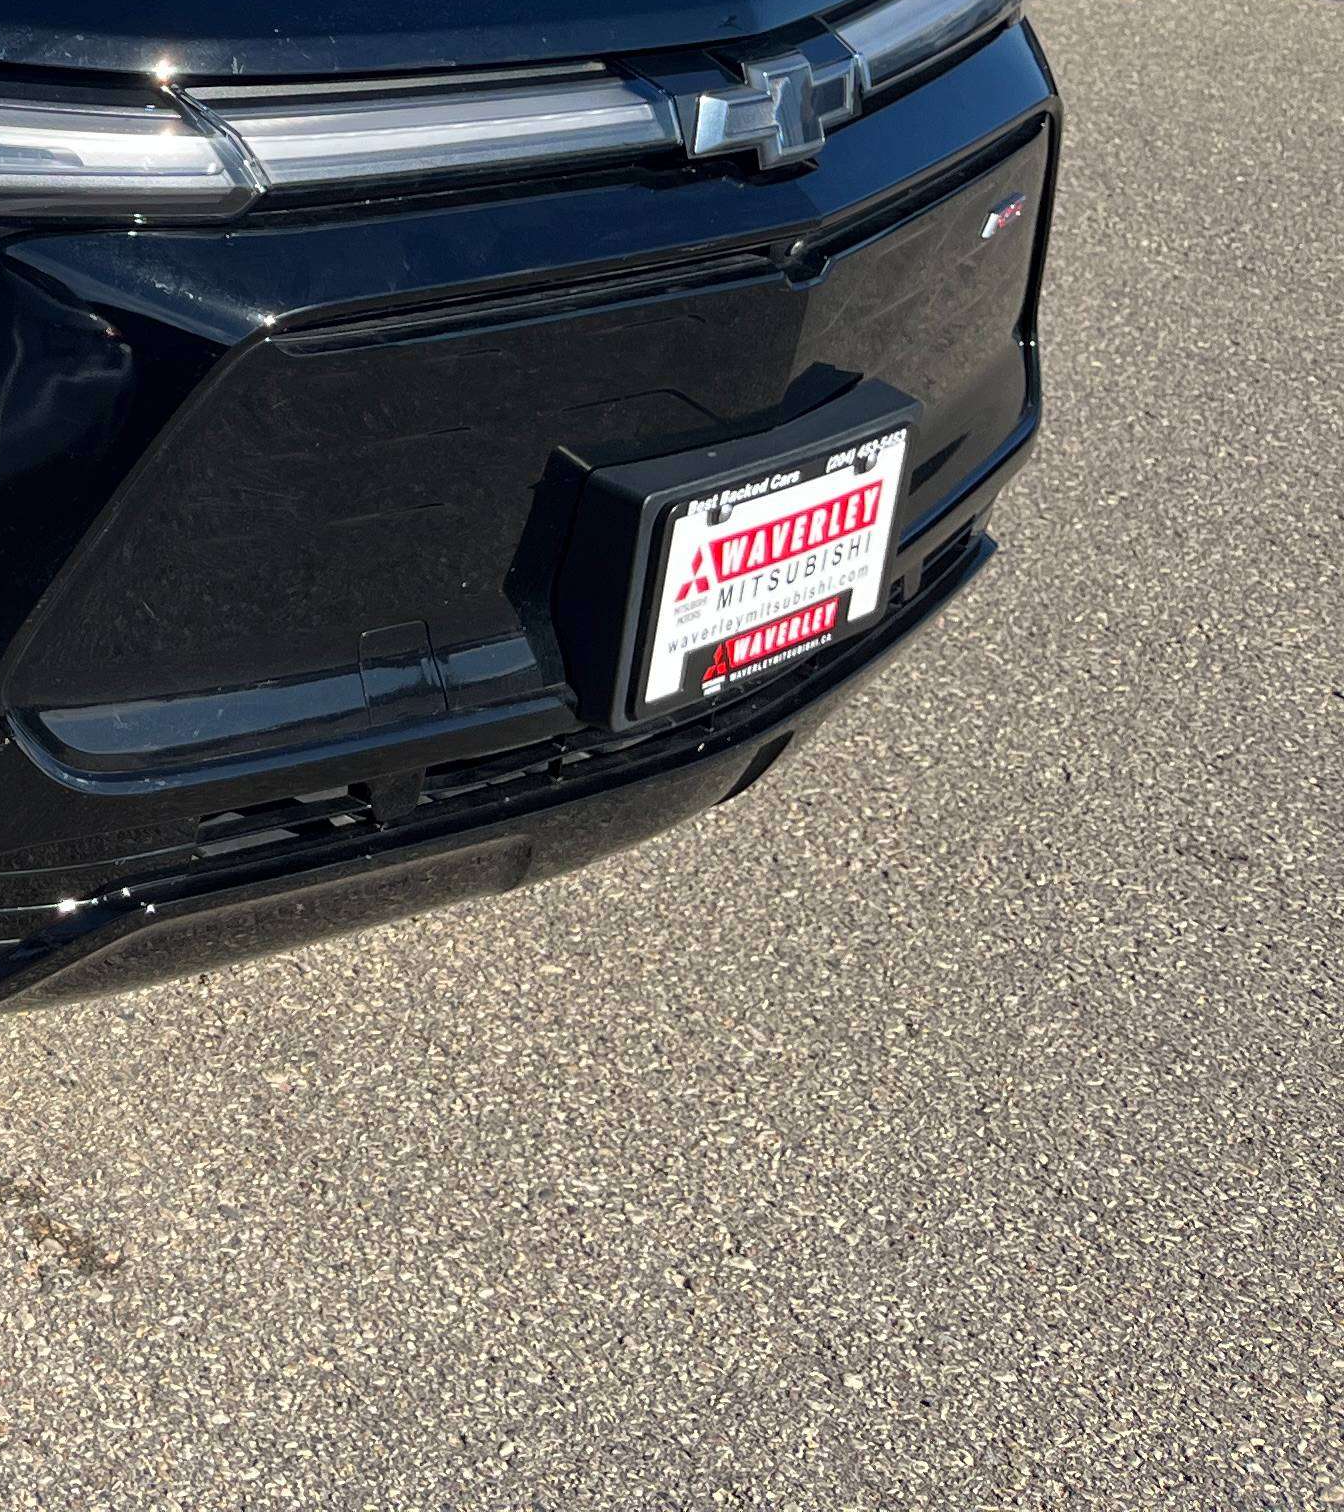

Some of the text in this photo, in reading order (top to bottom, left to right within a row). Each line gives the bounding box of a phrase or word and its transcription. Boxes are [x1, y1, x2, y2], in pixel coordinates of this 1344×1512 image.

[770, 470, 801, 490] Cars
[720, 483, 883, 578] WAVERLEY
[667, 564, 870, 655] waverleymitsubishi.com
[716, 532, 871, 611] MITSUBISHI
[732, 601, 838, 663] WAVERLEY
